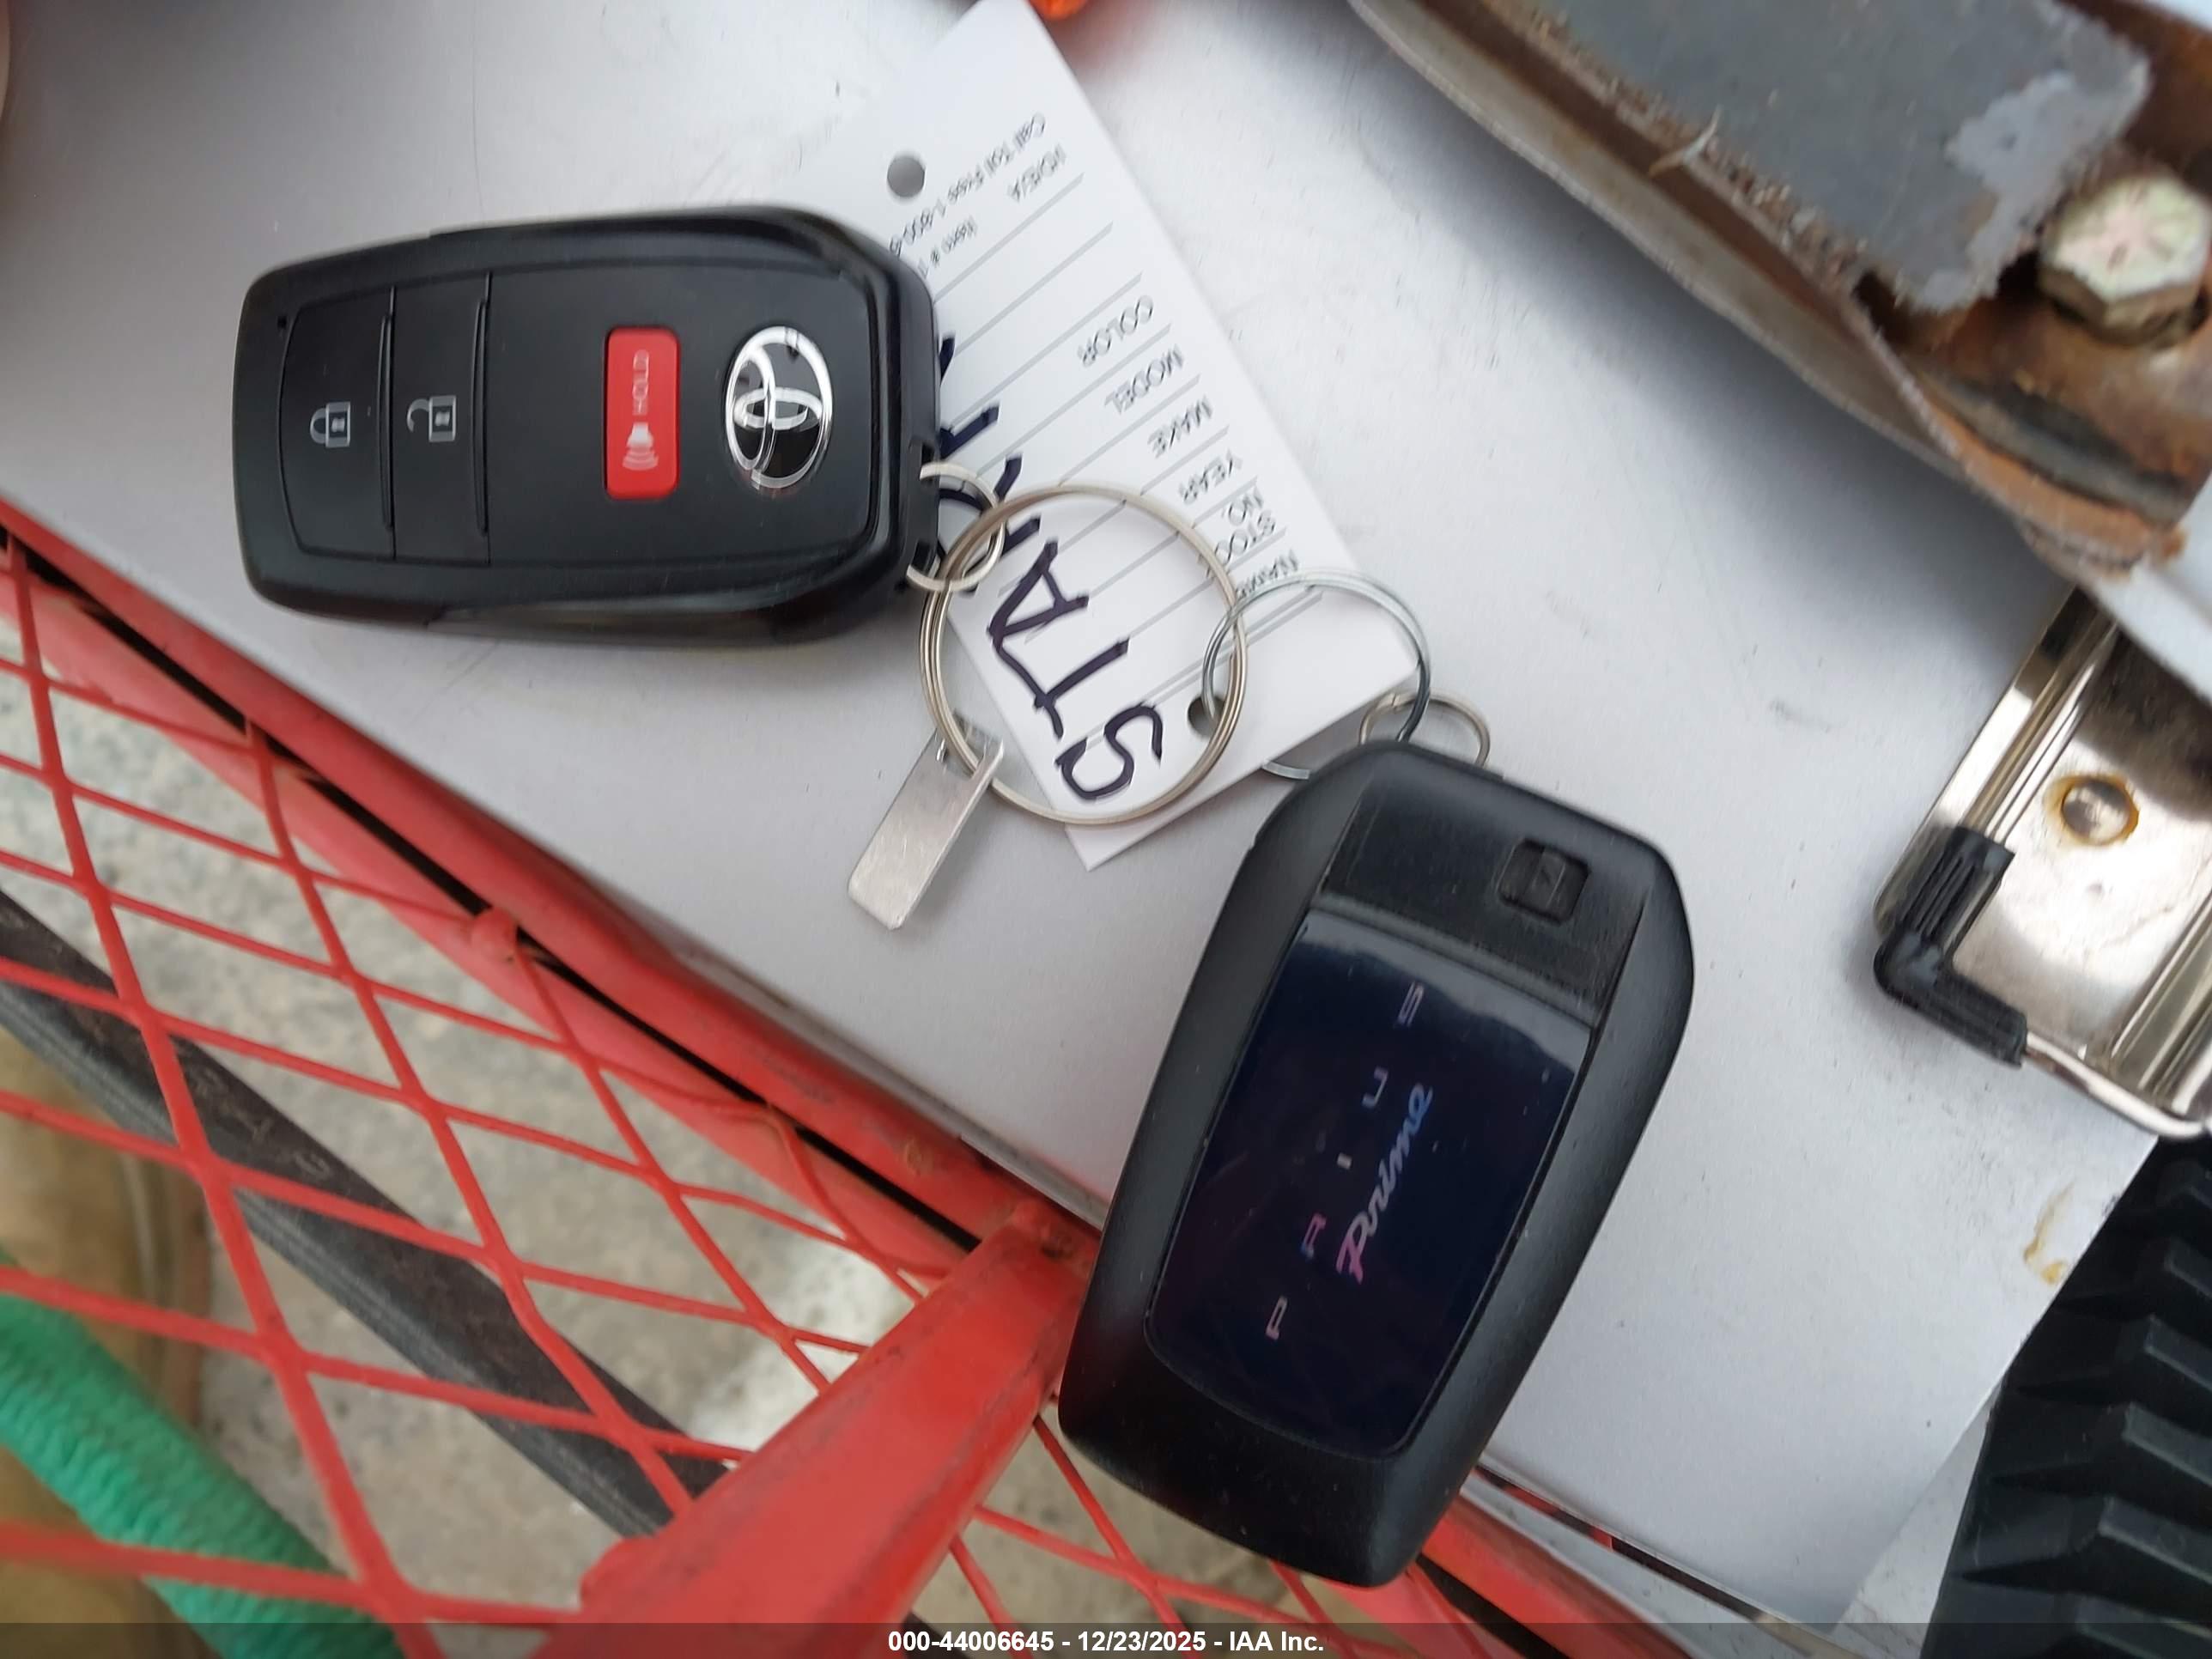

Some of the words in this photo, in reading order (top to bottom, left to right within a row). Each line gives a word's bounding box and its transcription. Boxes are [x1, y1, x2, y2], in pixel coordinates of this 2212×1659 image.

[985, 140, 1014, 177] Toll
[1013, 112, 1046, 153] Call
[948, 165, 985, 204] Free
[1077, 295, 1154, 367] COLOR
[632, 349, 650, 416] HOLD
[1104, 343, 1185, 415] MODEL
[1147, 394, 1213, 459] MAKE
[1178, 448, 1243, 505] YEAR
[1335, 1082, 1434, 1285] Prime
